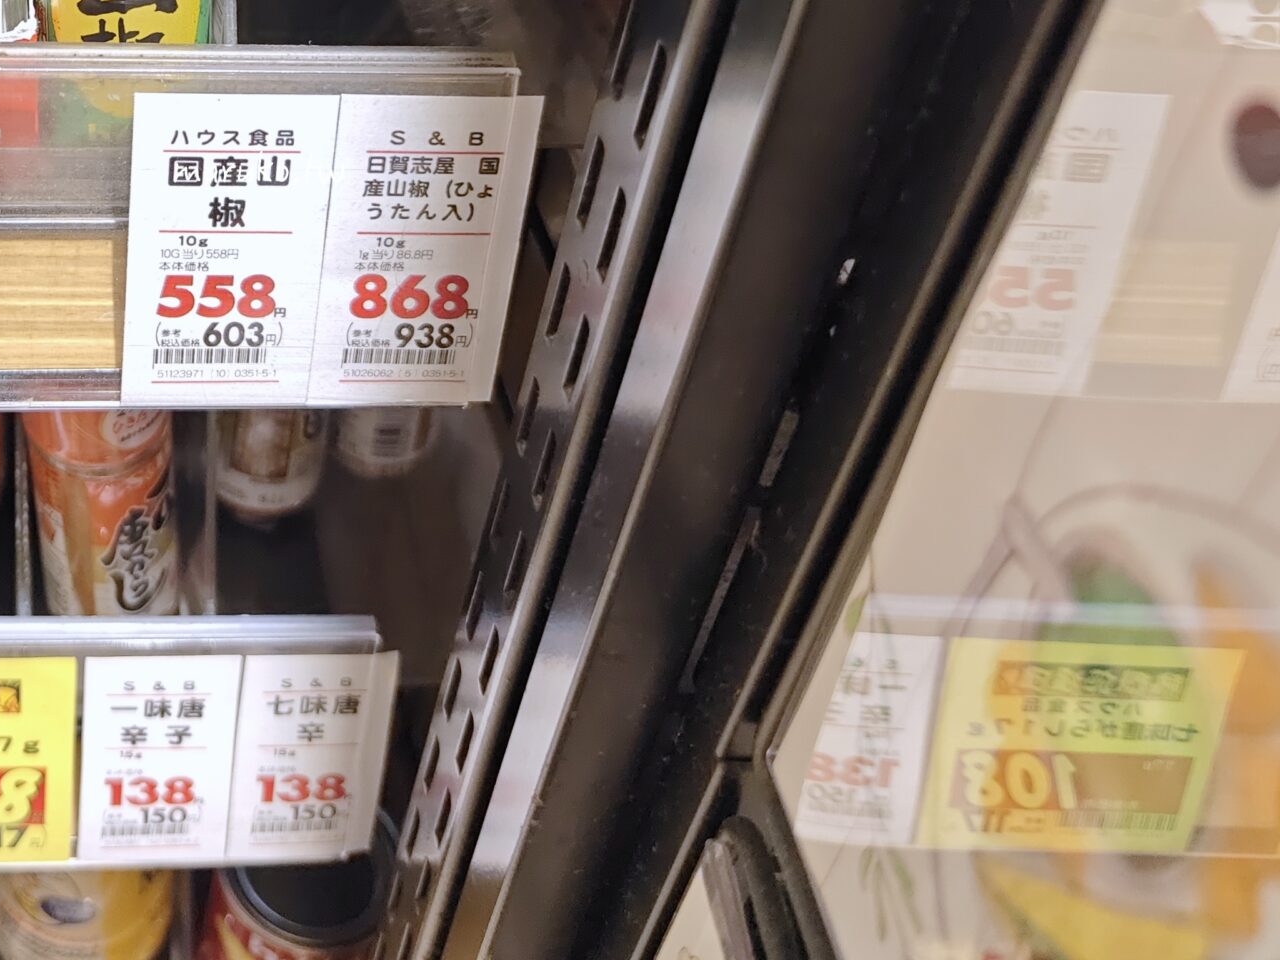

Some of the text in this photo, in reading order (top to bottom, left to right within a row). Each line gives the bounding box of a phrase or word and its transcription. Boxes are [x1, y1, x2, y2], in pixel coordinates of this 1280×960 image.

[171, 129, 295, 146] ハウス食品
[366, 156, 455, 175] 日賀志屋
[362, 180, 430, 198] 産山椒
[208, 197, 246, 227] 椒
[366, 203, 475, 222] うたん入)
[179, 236, 208, 247] 10g
[376, 237, 405, 248] 10g
[159, 261, 210, 272] 本体価格
[110, 699, 206, 719] 一味唐
[266, 694, 361, 715] 七味唐
[121, 726, 193, 745] 辛子
[297, 722, 325, 742] 辛
[104, 776, 195, 806] 138
[256, 773, 346, 803] 138
[139, 807, 188, 824] 150
[290, 803, 338, 821] 150
